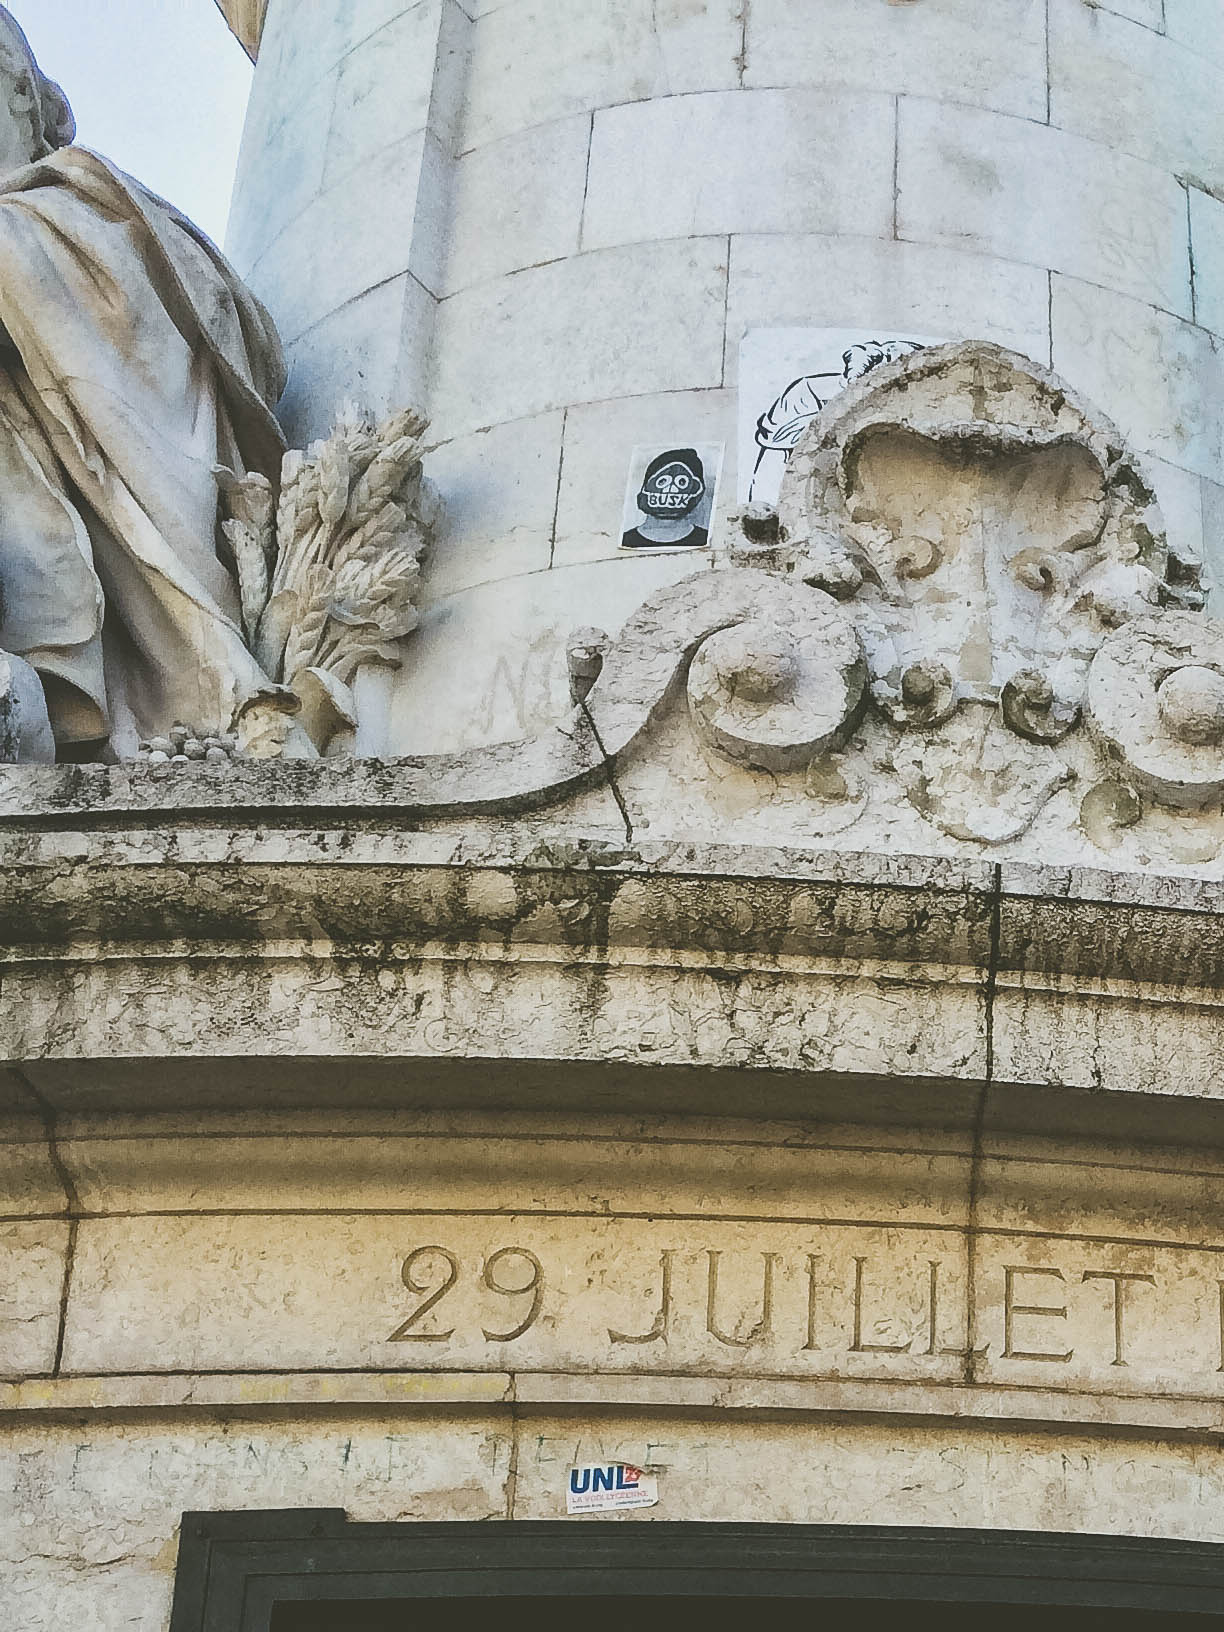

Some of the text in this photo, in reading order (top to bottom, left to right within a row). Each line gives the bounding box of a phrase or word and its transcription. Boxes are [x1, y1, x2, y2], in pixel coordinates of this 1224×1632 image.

[647, 494, 689, 508] BUSK
[387, 1244, 545, 1344] 29
[606, 1247, 1157, 1368] JUILLET
[570, 1464, 639, 1494] UNL
